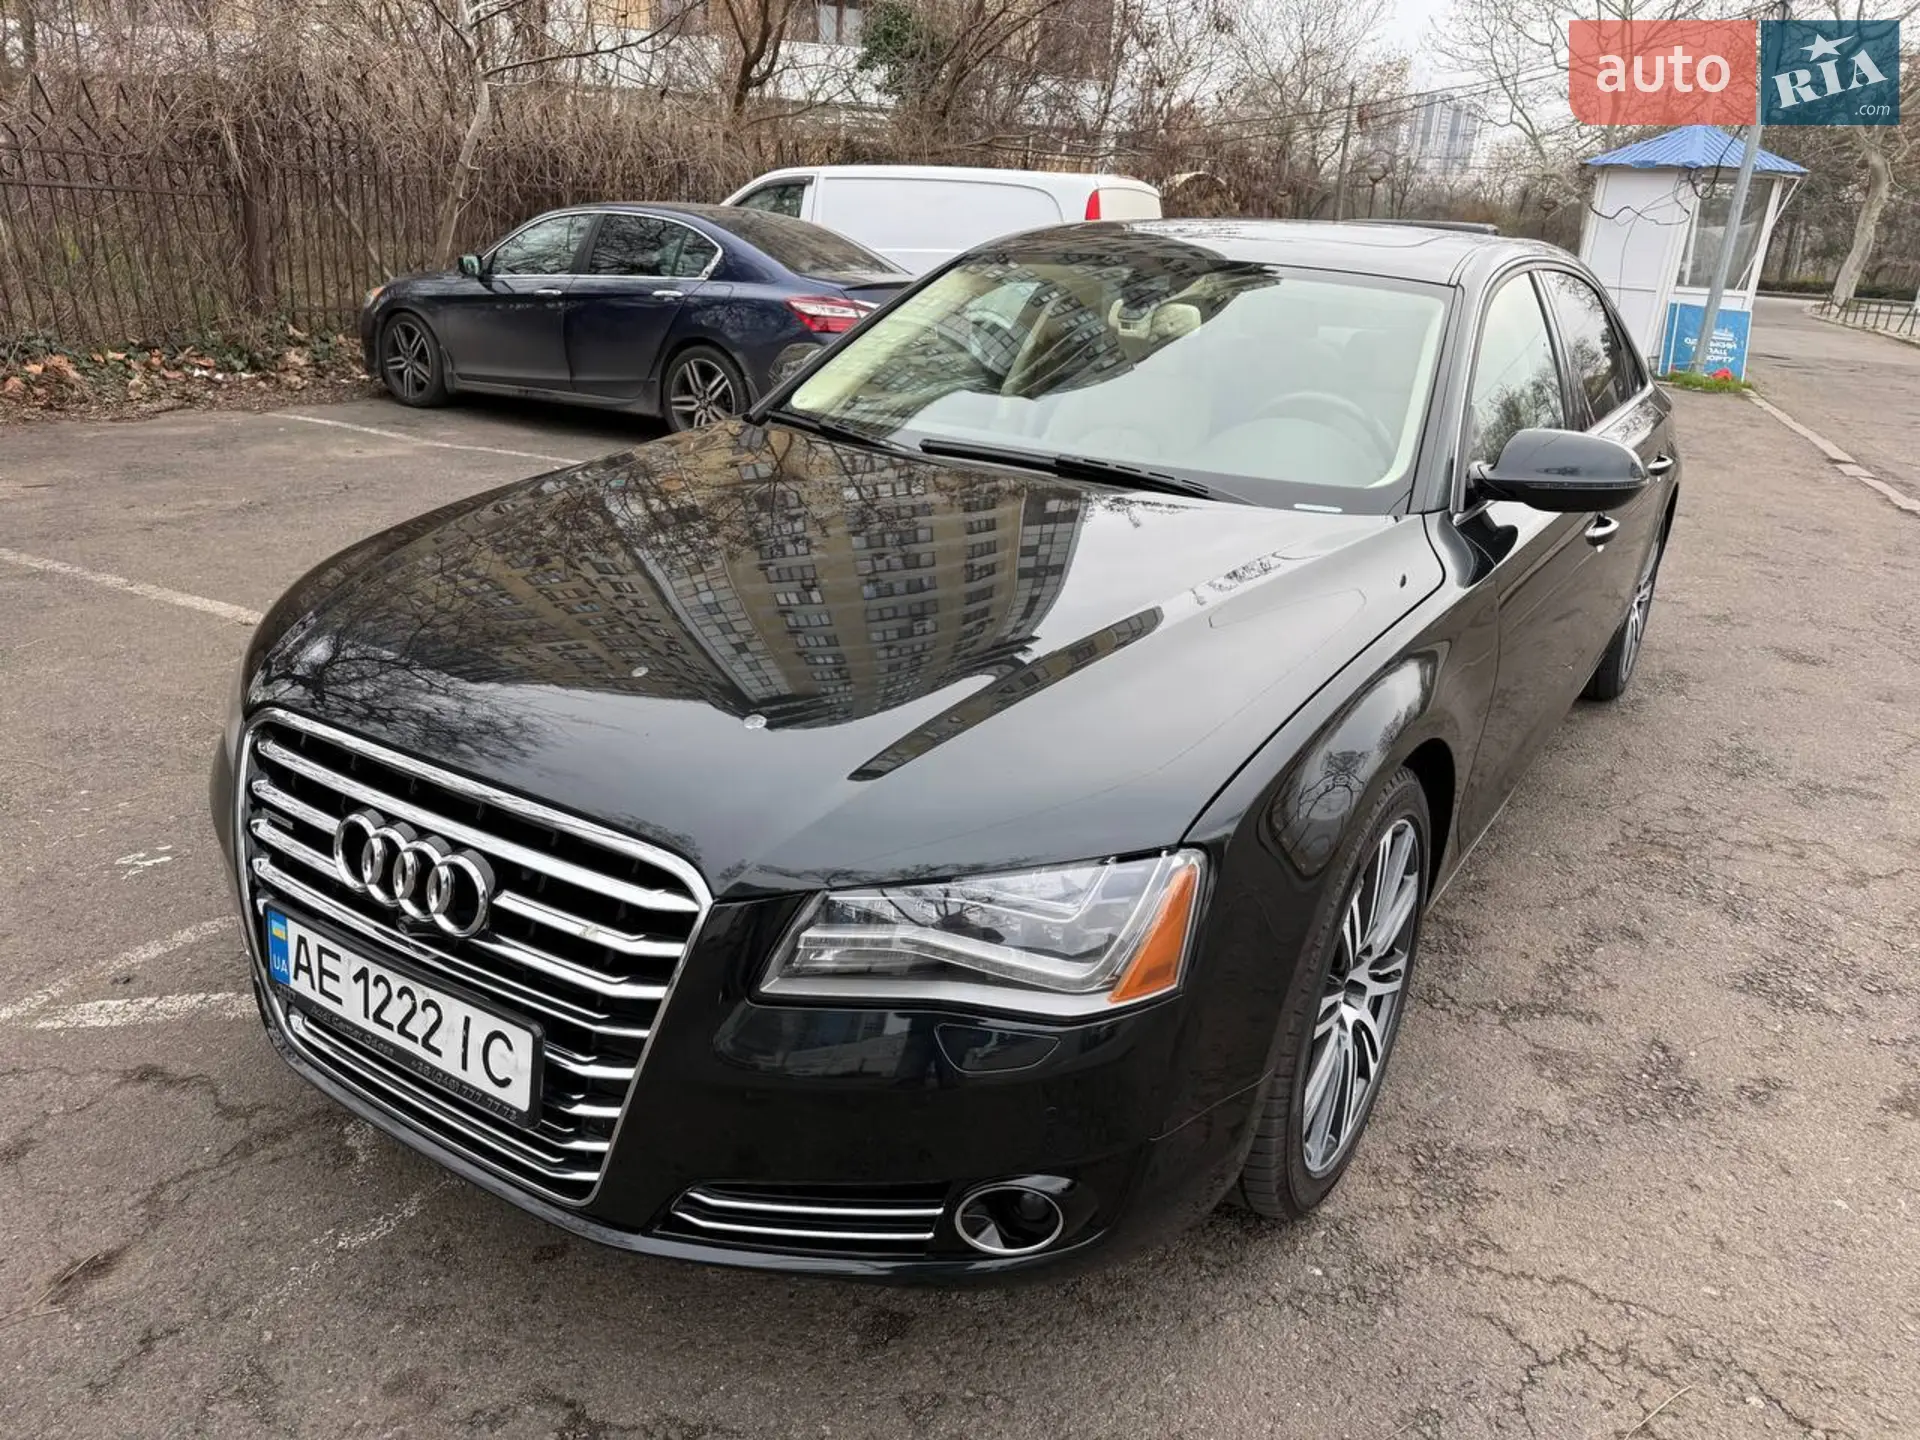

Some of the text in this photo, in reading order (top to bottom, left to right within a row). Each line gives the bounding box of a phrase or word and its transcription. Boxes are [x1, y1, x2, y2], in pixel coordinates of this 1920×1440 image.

[272, 953, 289, 975] UA
[293, 934, 513, 1088] AE 1222 IC
